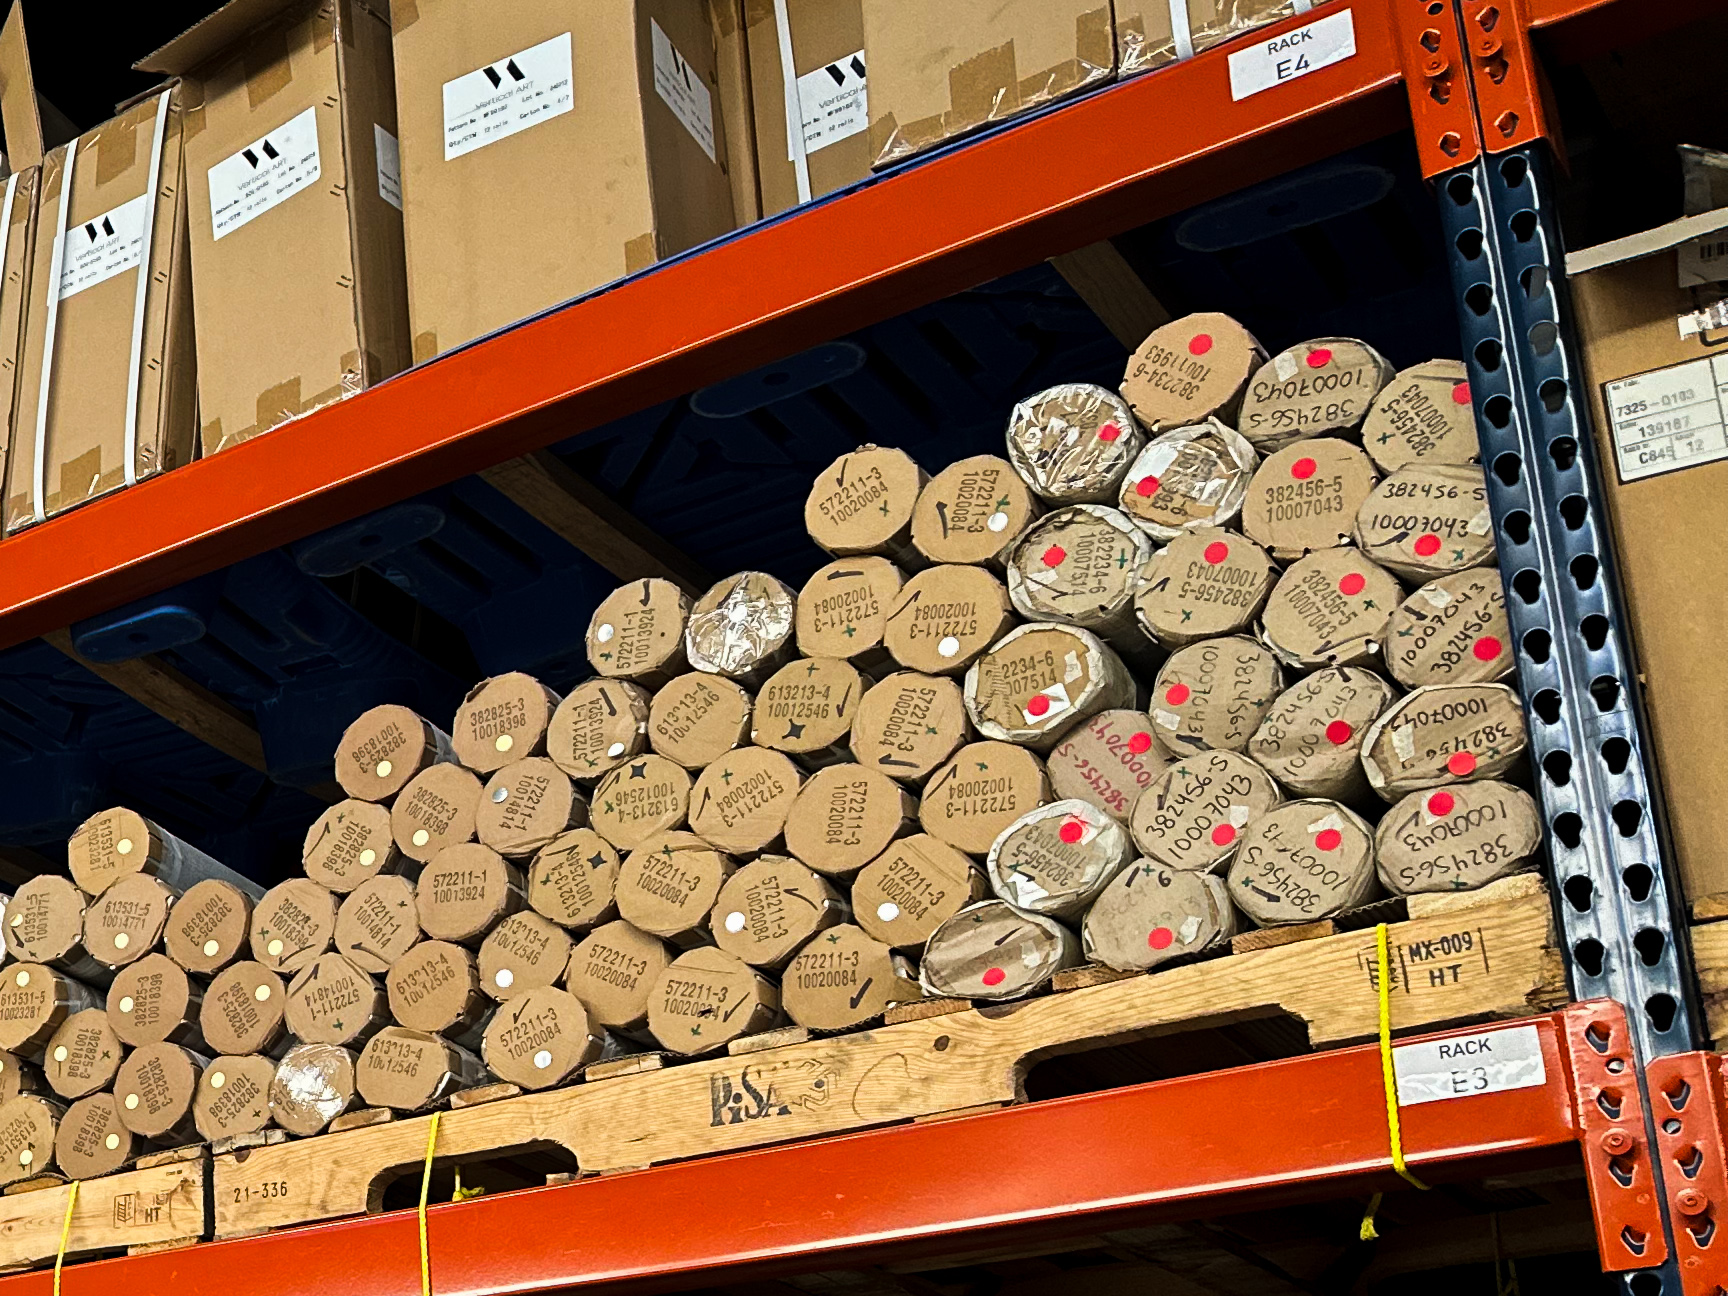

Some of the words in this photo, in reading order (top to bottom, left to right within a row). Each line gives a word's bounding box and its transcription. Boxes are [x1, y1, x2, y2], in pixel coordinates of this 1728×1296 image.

[1268, 29, 1312, 55] RACK
[1276, 53, 1310, 80] E4
[819, 87, 858, 108] Vertical
[1145, 345, 1212, 382] 10011993
[1133, 363, 1200, 400] 382234-6
[1253, 370, 1362, 402] 10007043
[819, 467, 882, 515] 572211-3
[830, 481, 889, 526] 10020084
[949, 472, 980, 531] 10020084
[968, 469, 999, 533] 572211-3
[1266, 477, 1342, 504] 382456-5
[1266, 496, 1343, 522] 10007043
[1372, 515, 1469, 537] 10007043
[1071, 532, 1087, 596] 10007514
[1089, 528, 1114, 595] 382234-6
[1188, 562, 1256, 587] 10007043
[1302, 570, 1358, 626] 382456-5
[617, 611, 638, 670] 572211-1
[635, 608, 655, 665] 10013924
[471, 698, 525, 726] 382825-3
[352, 722, 400, 762] 10018398
[413, 786, 458, 820] 382825-3
[844, 781, 869, 846] 572211-3
[1146, 756, 1229, 838] 382456-5
[1168, 775, 1252, 859] 10007043
[101, 819, 115, 870] 613531-5
[433, 870, 487, 887] 572211-1
[643, 855, 700, 891] 572211-3
[25, 894, 38, 943] 613531-5
[589, 944, 647, 975] 572211-3
[796, 952, 859, 971] 572211-3
[1409, 931, 1473, 963] MX-009
[665, 980, 728, 1002] 572211-3
[798, 970, 857, 989] 10020084
[1429, 964, 1462, 988] HT
[135, 976, 149, 1026] 382825-3
[229, 982, 260, 1028] 10018398
[310, 989, 359, 1021] 572211-1
[500, 1008, 557, 1046] 572211-3
[508, 1026, 561, 1060] 10020084
[1439, 1038, 1492, 1059] RACK
[1451, 1067, 1488, 1094] E3
[234, 1182, 288, 1203] 21-336
[145, 1207, 161, 1223] HT
